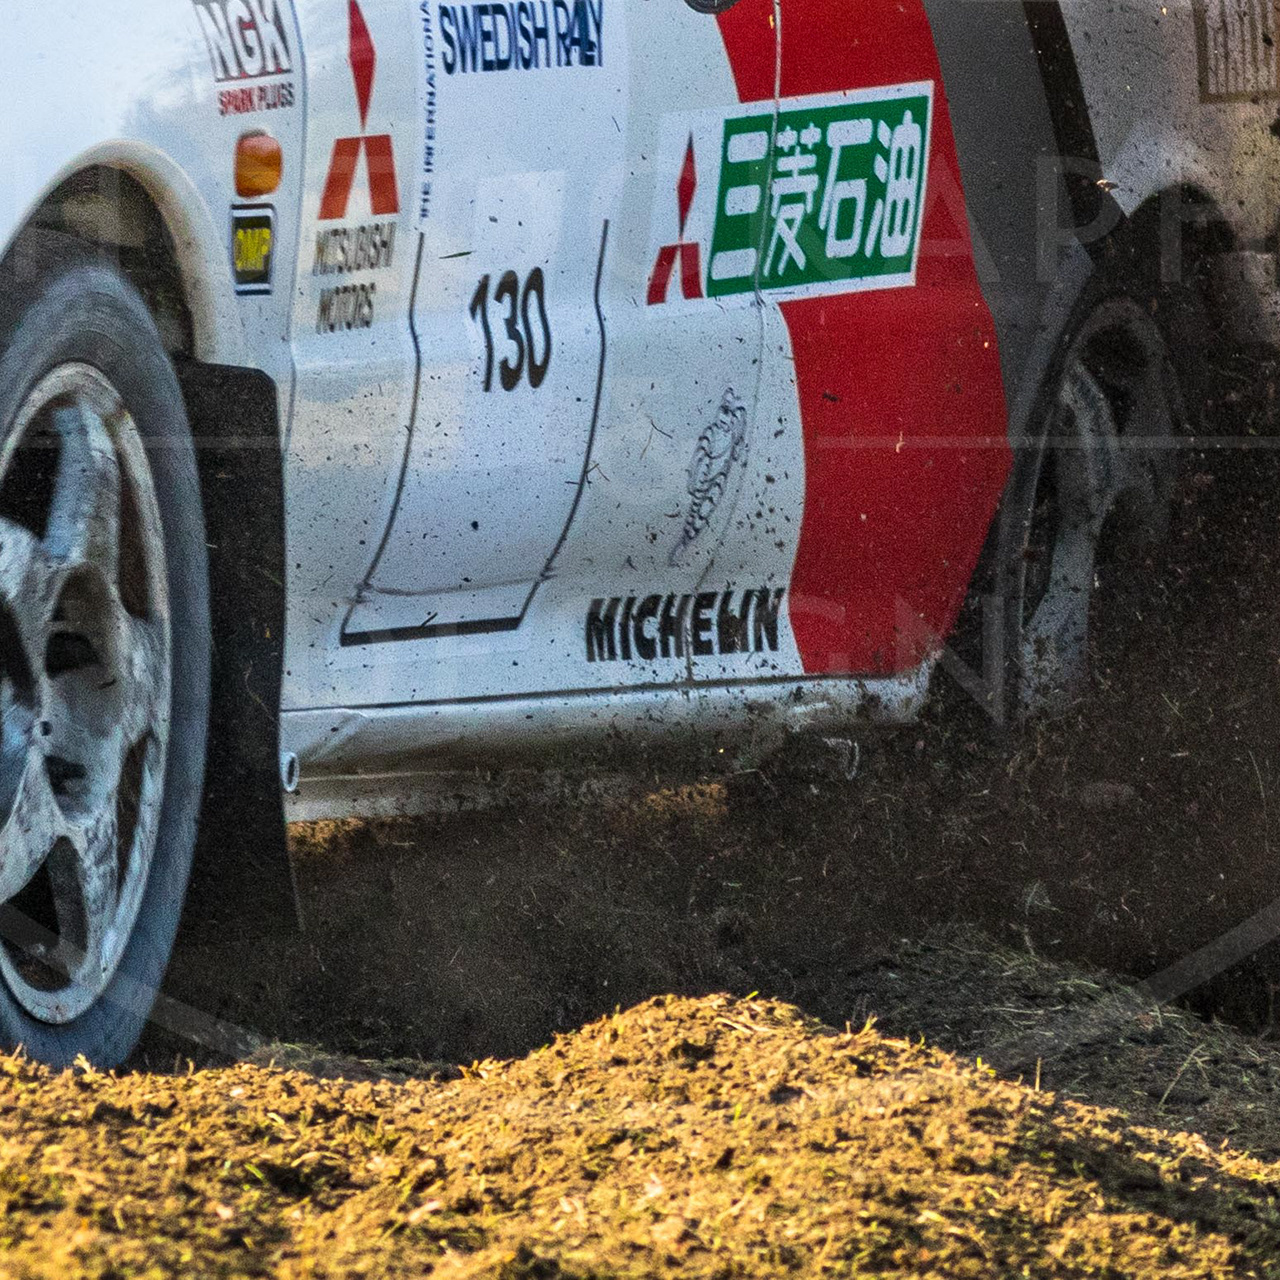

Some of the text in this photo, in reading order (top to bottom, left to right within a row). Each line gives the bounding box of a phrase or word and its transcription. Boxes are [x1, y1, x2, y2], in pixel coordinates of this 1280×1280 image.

[438, 0, 551, 75] SWEDISH
[710, 109, 922, 281] 三菱石油
[469, 266, 552, 393] 130
[585, 587, 786, 663] MICHELIN
